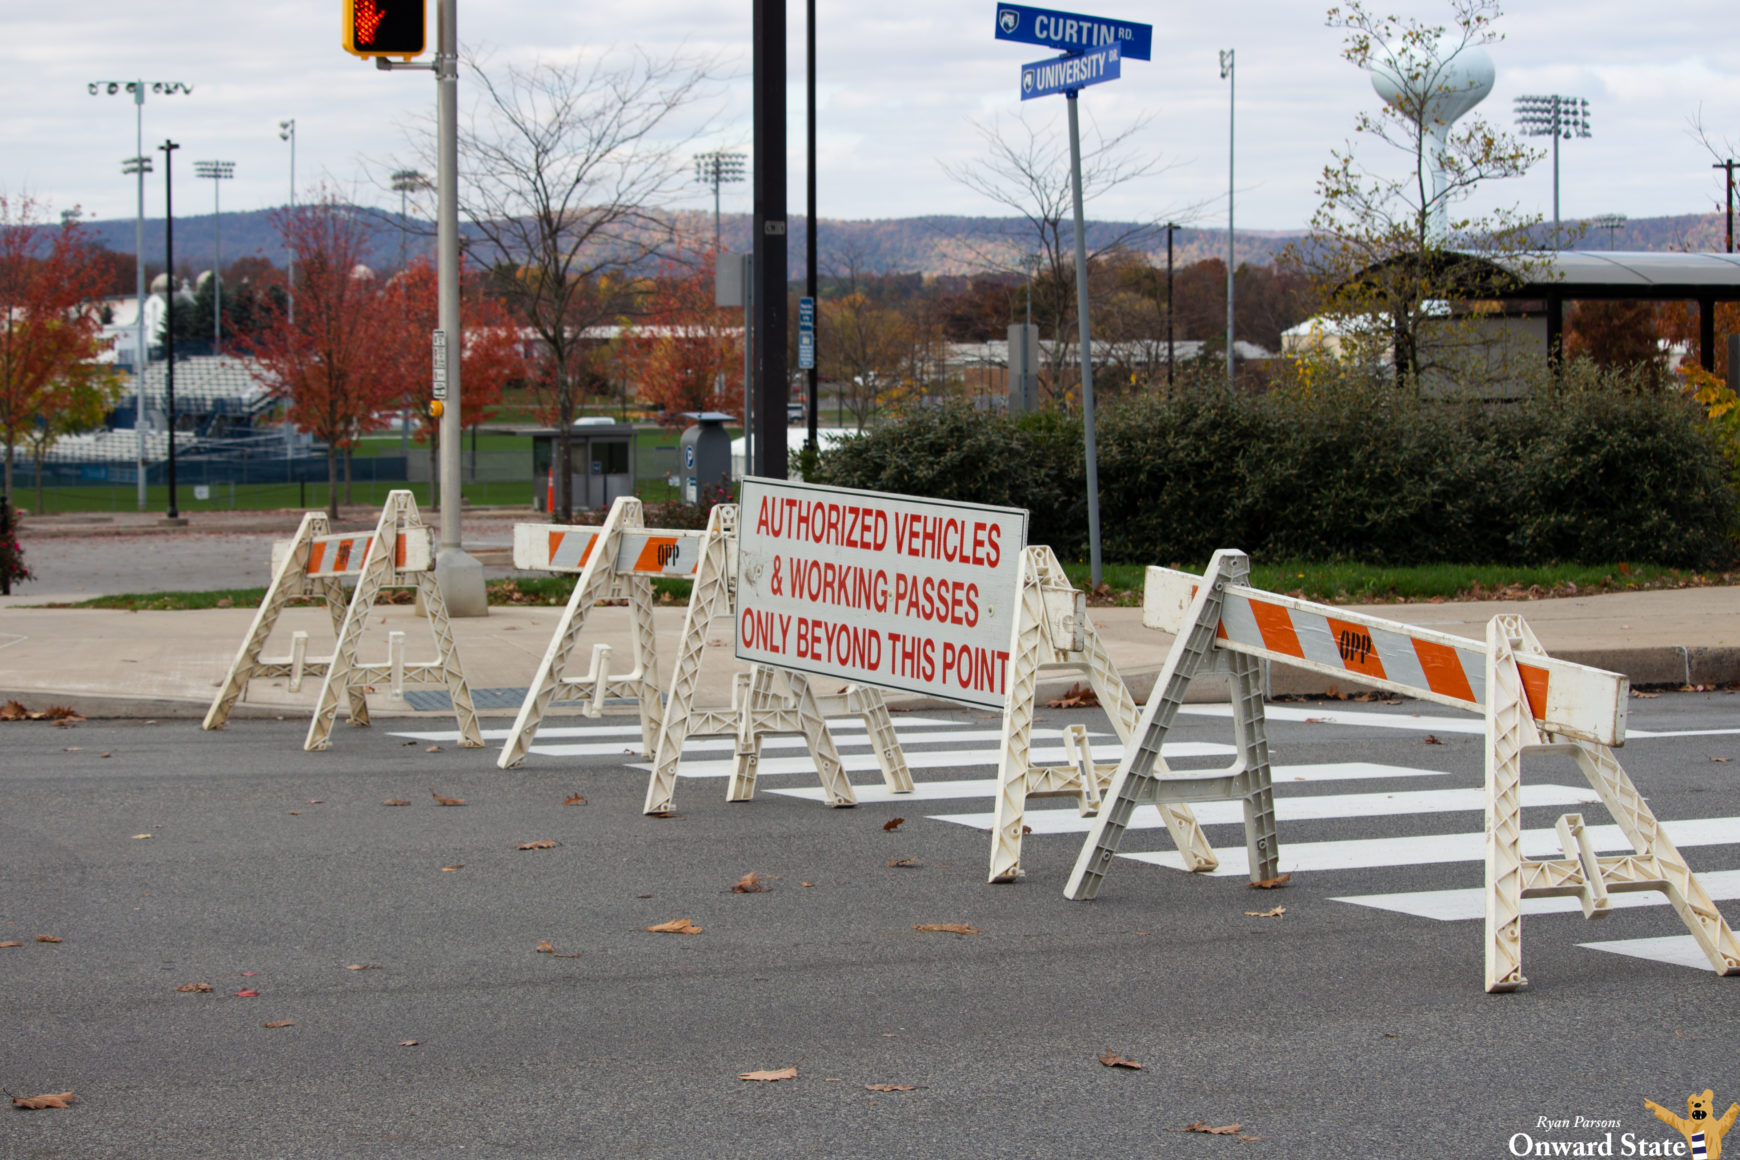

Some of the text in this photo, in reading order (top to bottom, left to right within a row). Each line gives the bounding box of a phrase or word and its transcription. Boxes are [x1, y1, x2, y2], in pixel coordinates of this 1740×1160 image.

[1035, 15, 1134, 46] CURTIN RD.
[1036, 52, 1106, 90] UNIVERSITY
[756, 495, 1001, 568] AUTHORIZED VEHICLES
[658, 544, 679, 566] OPP
[770, 554, 979, 628] & WORKING PASSES
[741, 607, 1009, 695] ONLY BEYOND THIS POINT
[1340, 630, 1371, 664] OPP
